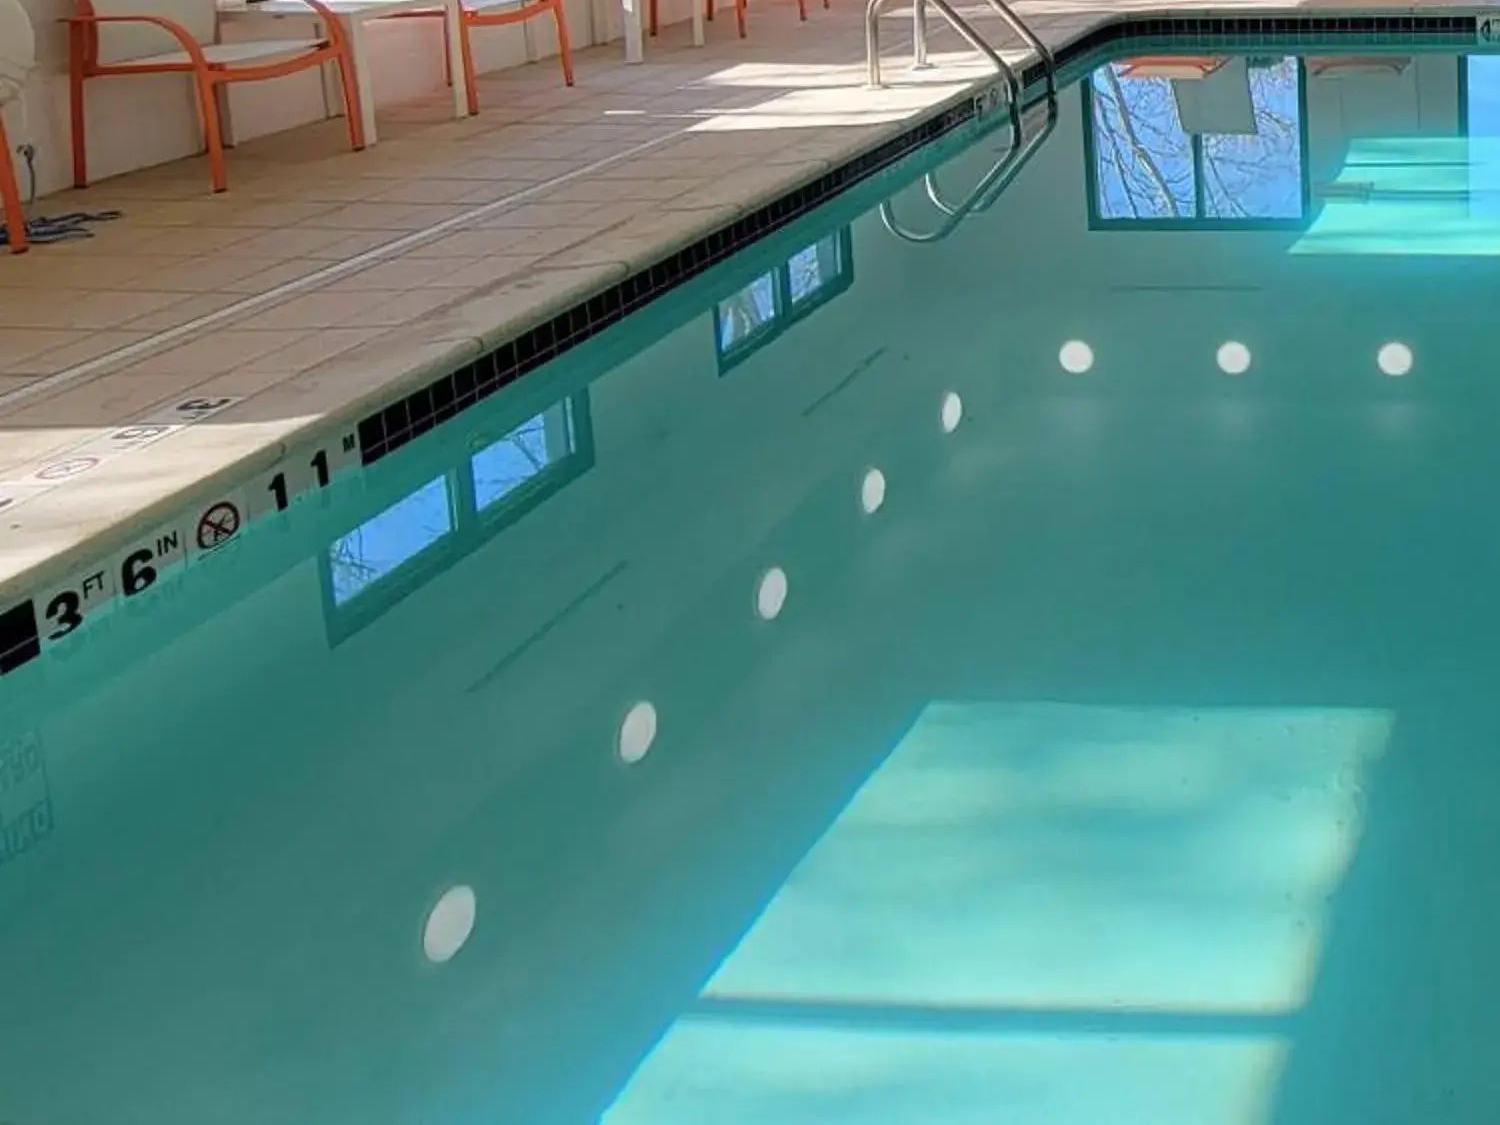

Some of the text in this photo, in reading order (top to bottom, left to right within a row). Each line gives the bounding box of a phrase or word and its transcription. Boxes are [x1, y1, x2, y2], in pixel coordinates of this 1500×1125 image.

[46, 531, 178, 640] 3 FT 6 IN
